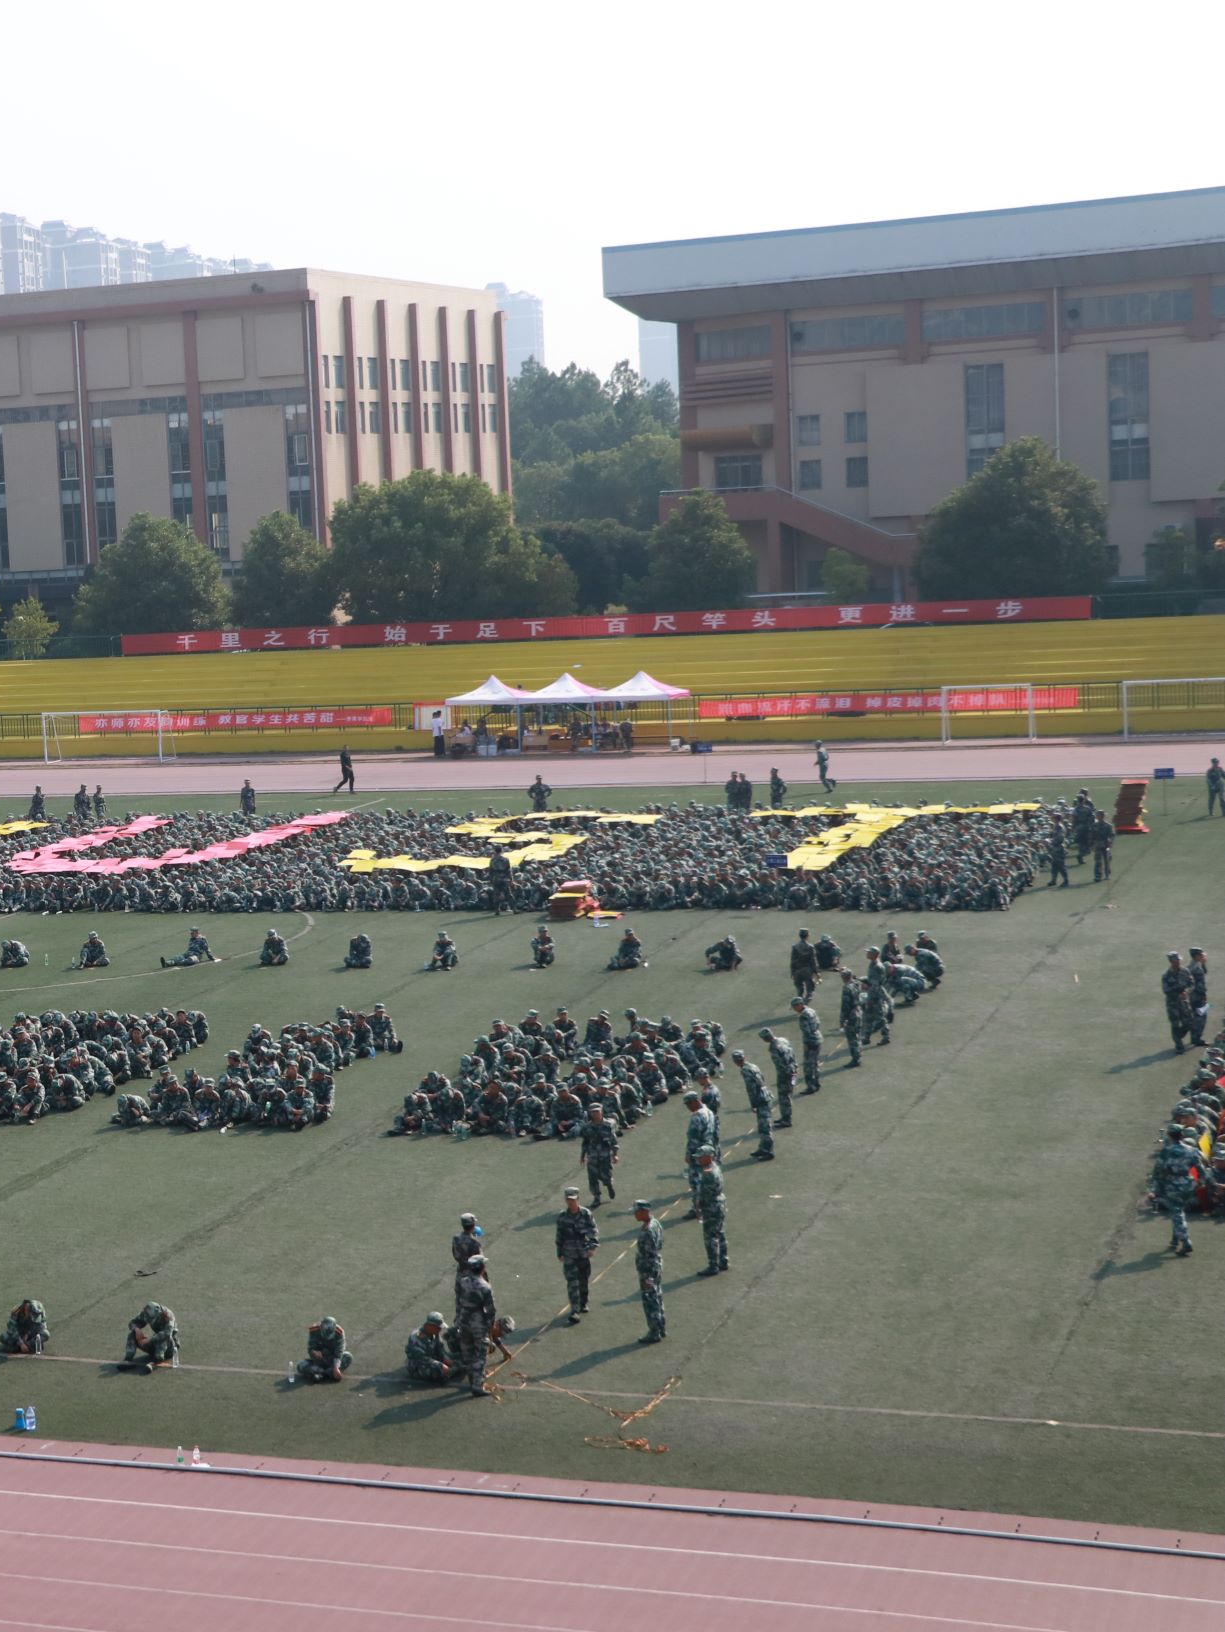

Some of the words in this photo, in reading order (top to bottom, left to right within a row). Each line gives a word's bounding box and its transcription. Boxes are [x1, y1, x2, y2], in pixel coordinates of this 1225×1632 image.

[176, 628, 330, 651] 千里之行
[383, 619, 548, 643] 始于足下
[604, 610, 777, 634] 百尺竿头
[838, 600, 1023, 625] 更进一步
[217, 712, 335, 726] 教官学生共苦甜
